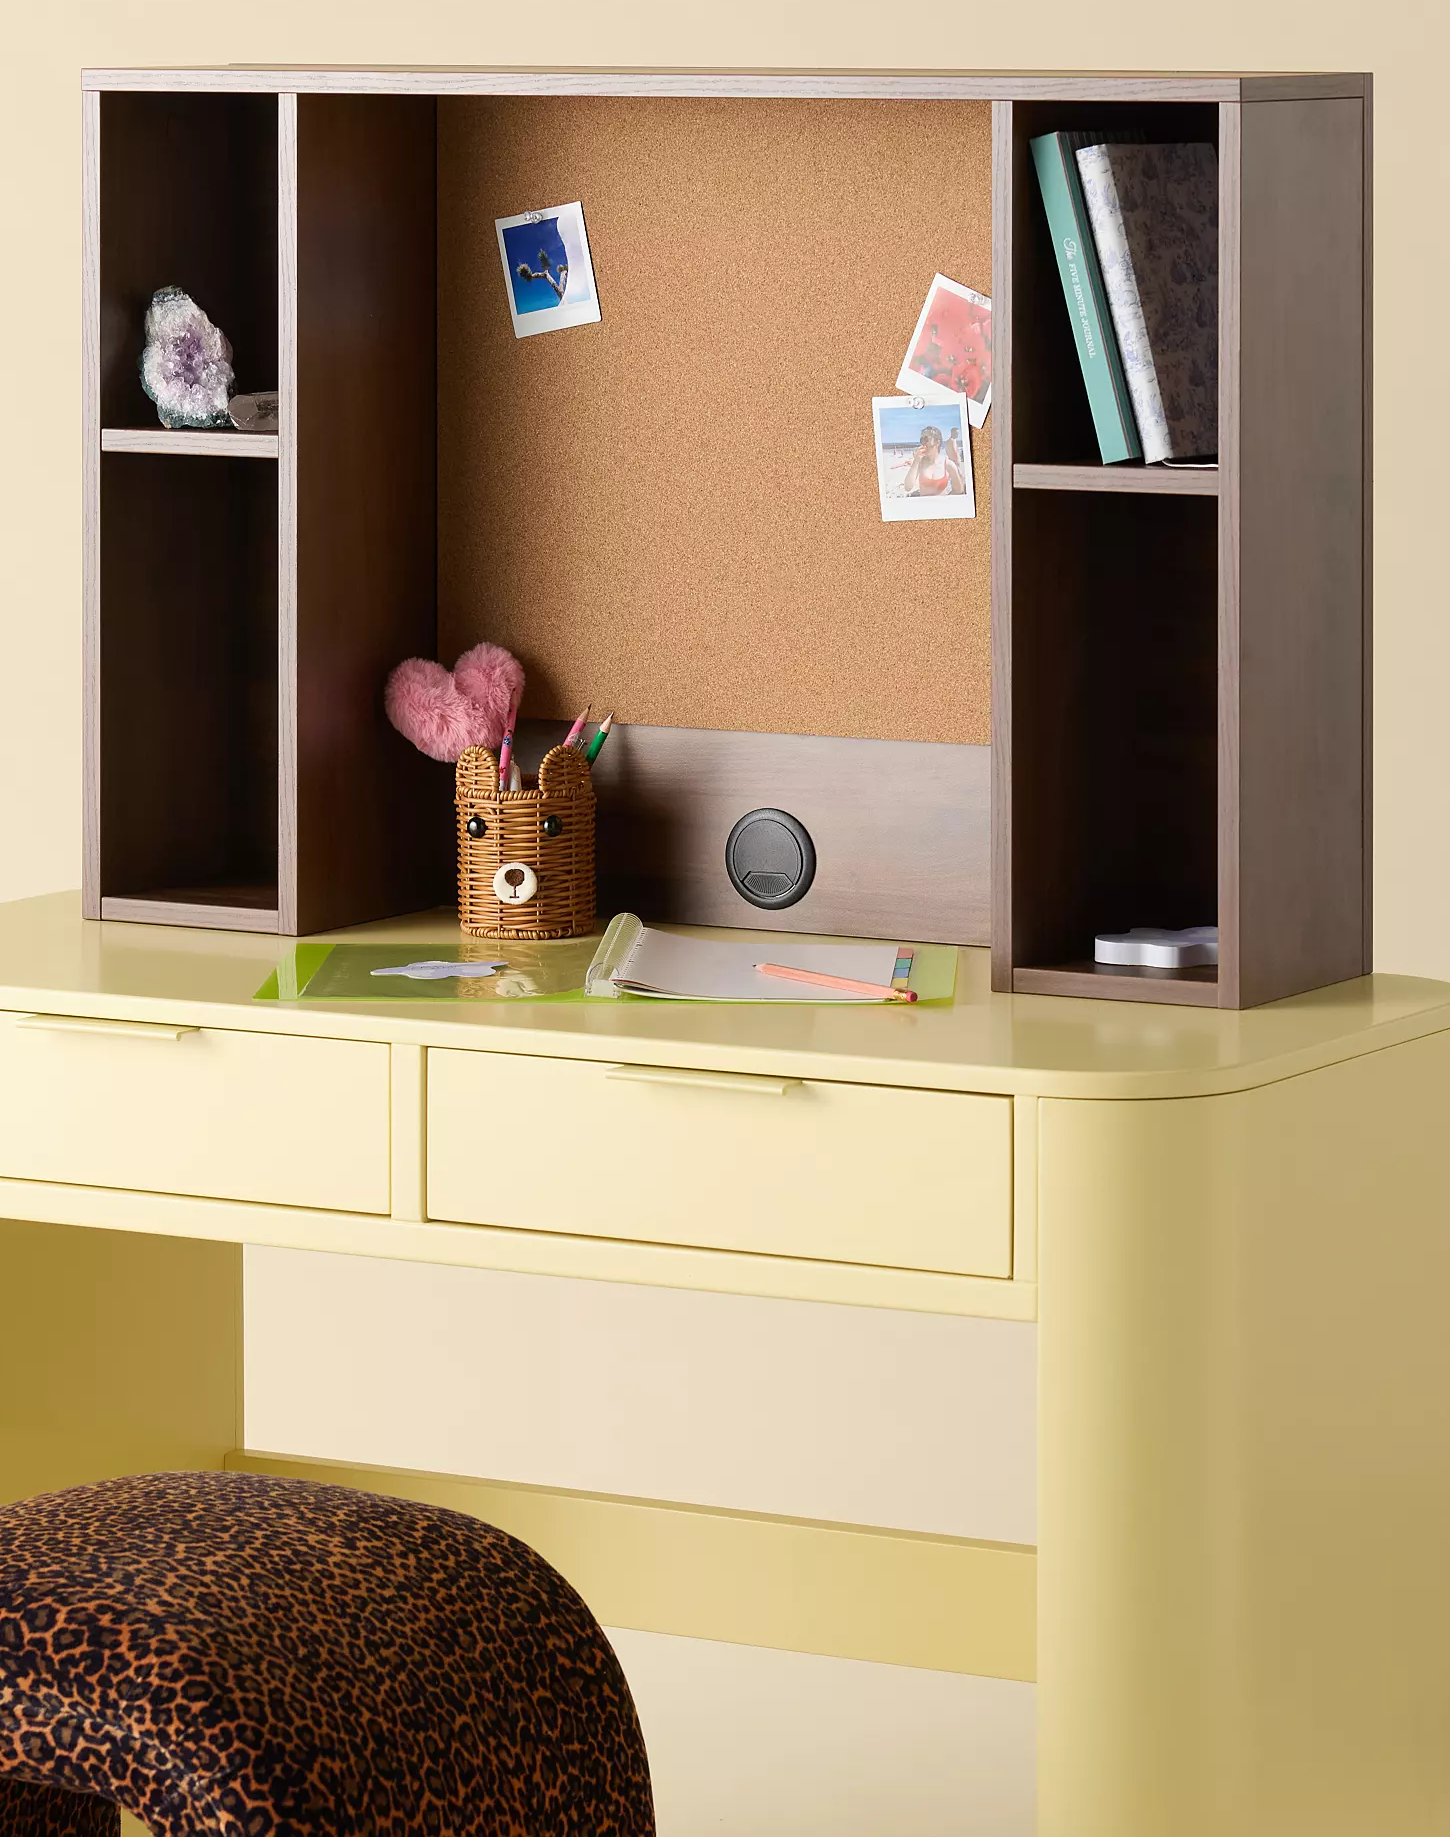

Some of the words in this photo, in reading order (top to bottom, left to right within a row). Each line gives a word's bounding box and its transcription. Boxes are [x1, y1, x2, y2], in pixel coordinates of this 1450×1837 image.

[1063, 238, 1077, 260] The
[1068, 263, 1080, 283] FIVE
[1074, 284, 1087, 317] MINUTE
[1081, 318, 1096, 358] JOURNAL
